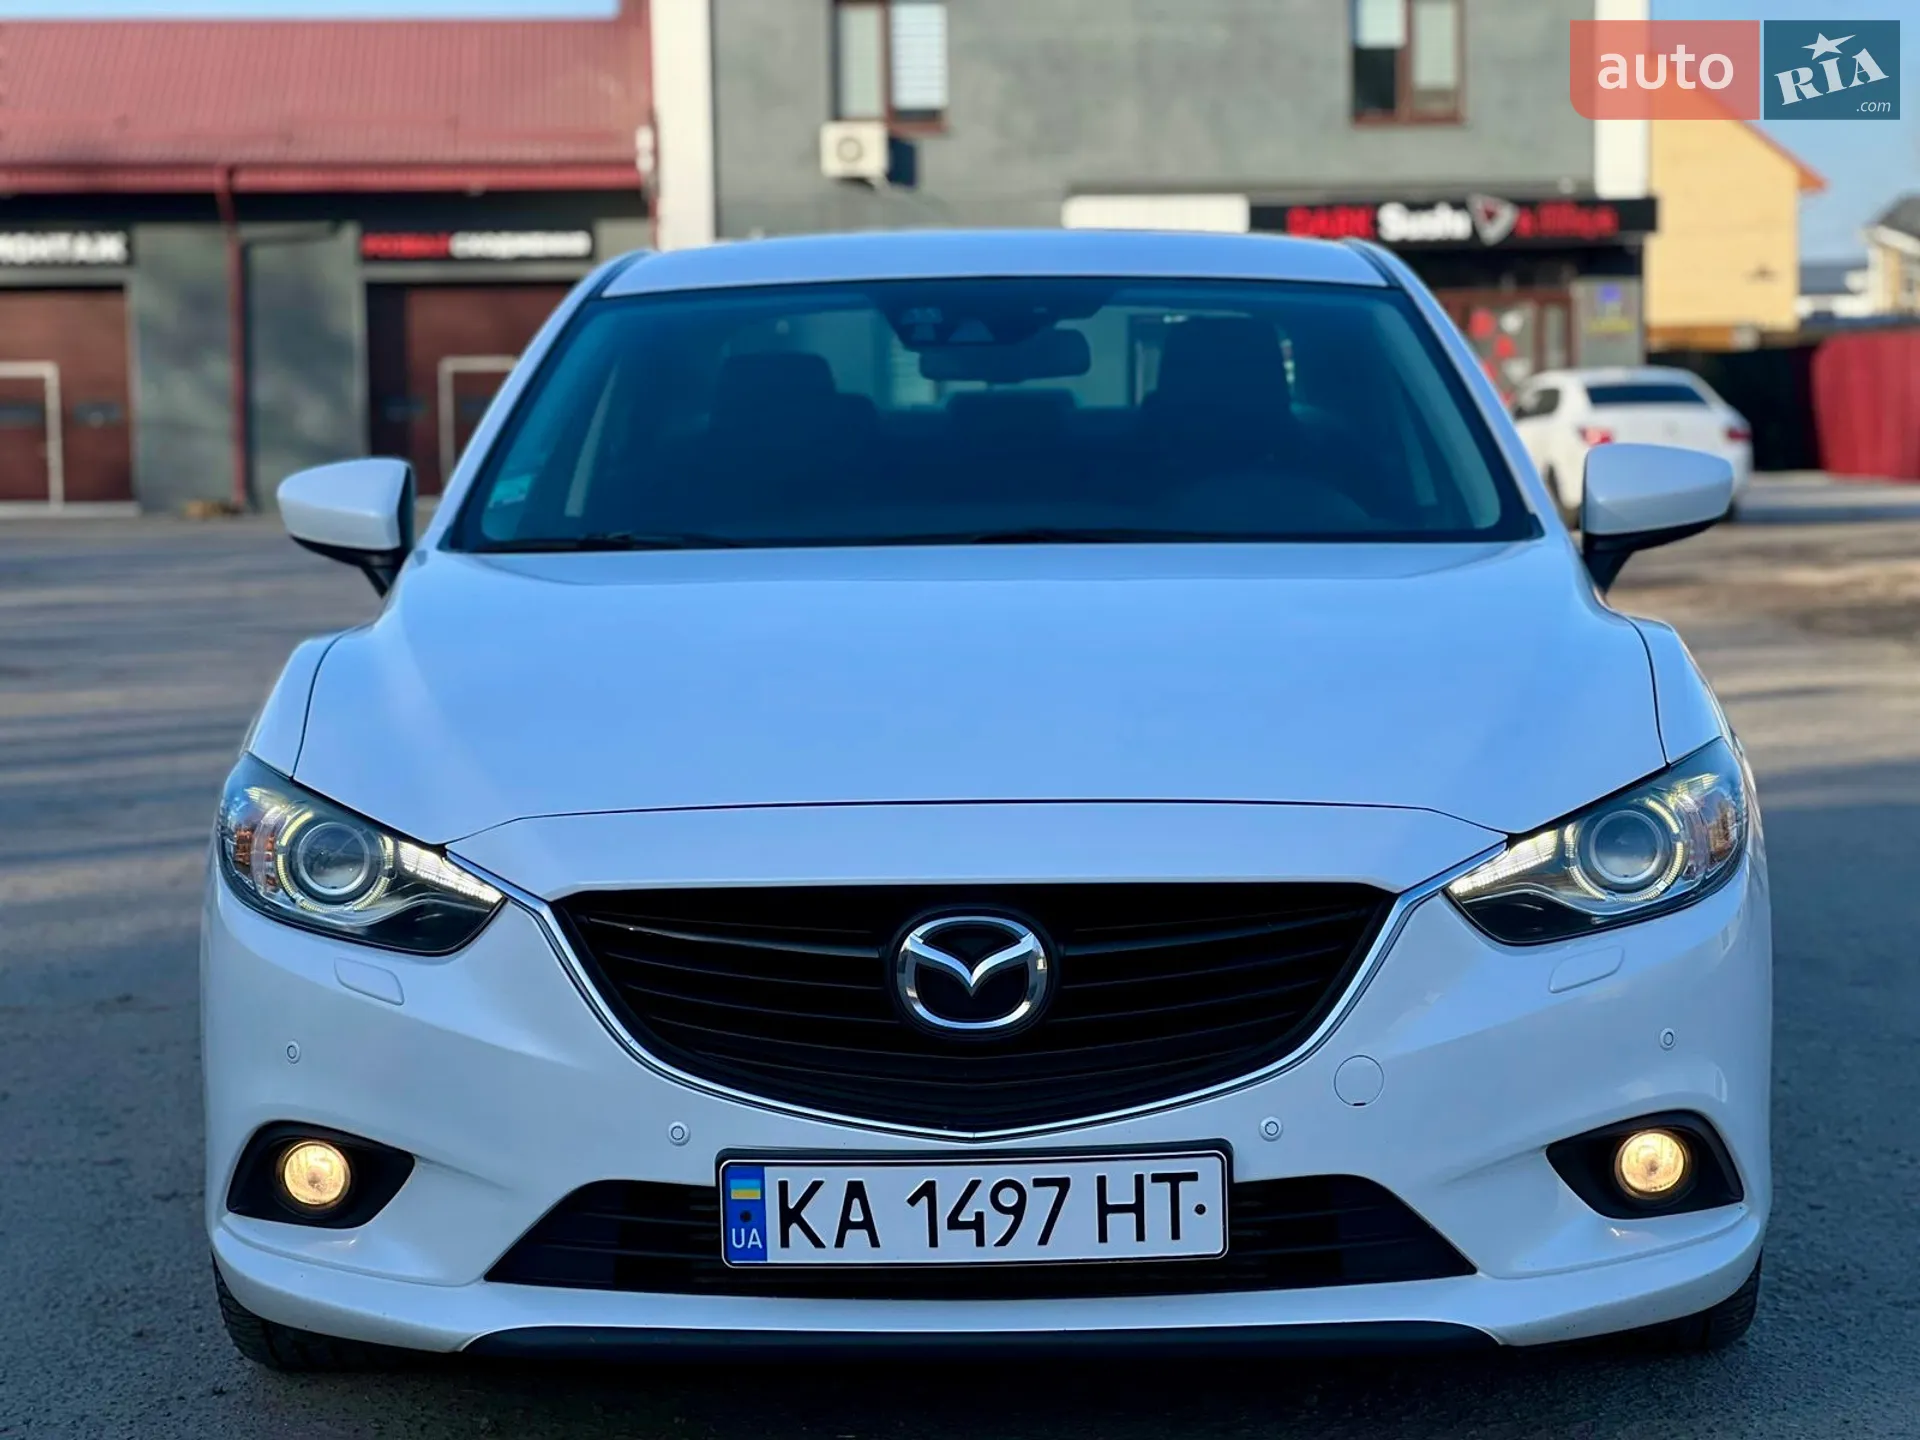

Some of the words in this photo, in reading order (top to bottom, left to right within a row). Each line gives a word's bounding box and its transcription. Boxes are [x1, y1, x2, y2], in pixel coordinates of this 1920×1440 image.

[777, 1179, 880, 1249] KA
[905, 1175, 1072, 1249] 1497
[1095, 1171, 1199, 1244] HT
[731, 1227, 763, 1250] UA
